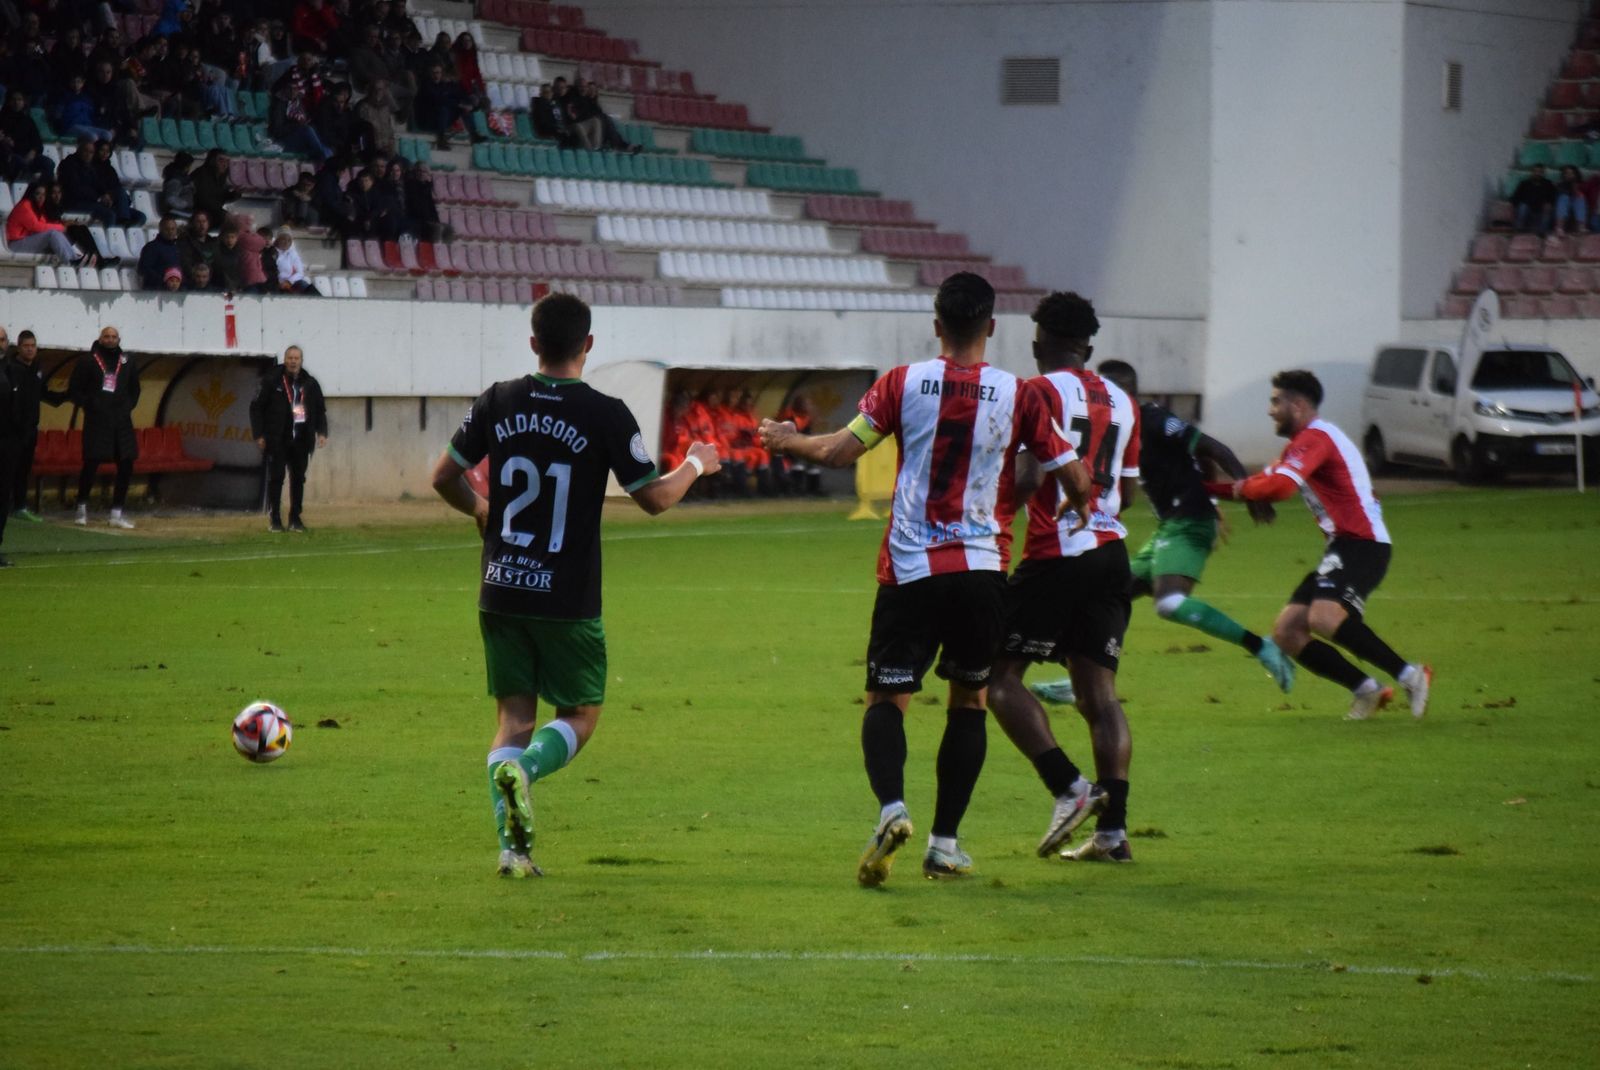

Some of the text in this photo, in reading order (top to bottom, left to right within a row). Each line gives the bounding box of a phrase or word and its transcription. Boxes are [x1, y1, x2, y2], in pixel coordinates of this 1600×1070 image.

[921, 379, 956, 397] DANI
[495, 413, 588, 454] ALDASORO
[931, 421, 969, 499] 7
[500, 456, 572, 553] 21
[485, 565, 552, 589] PASTOR
